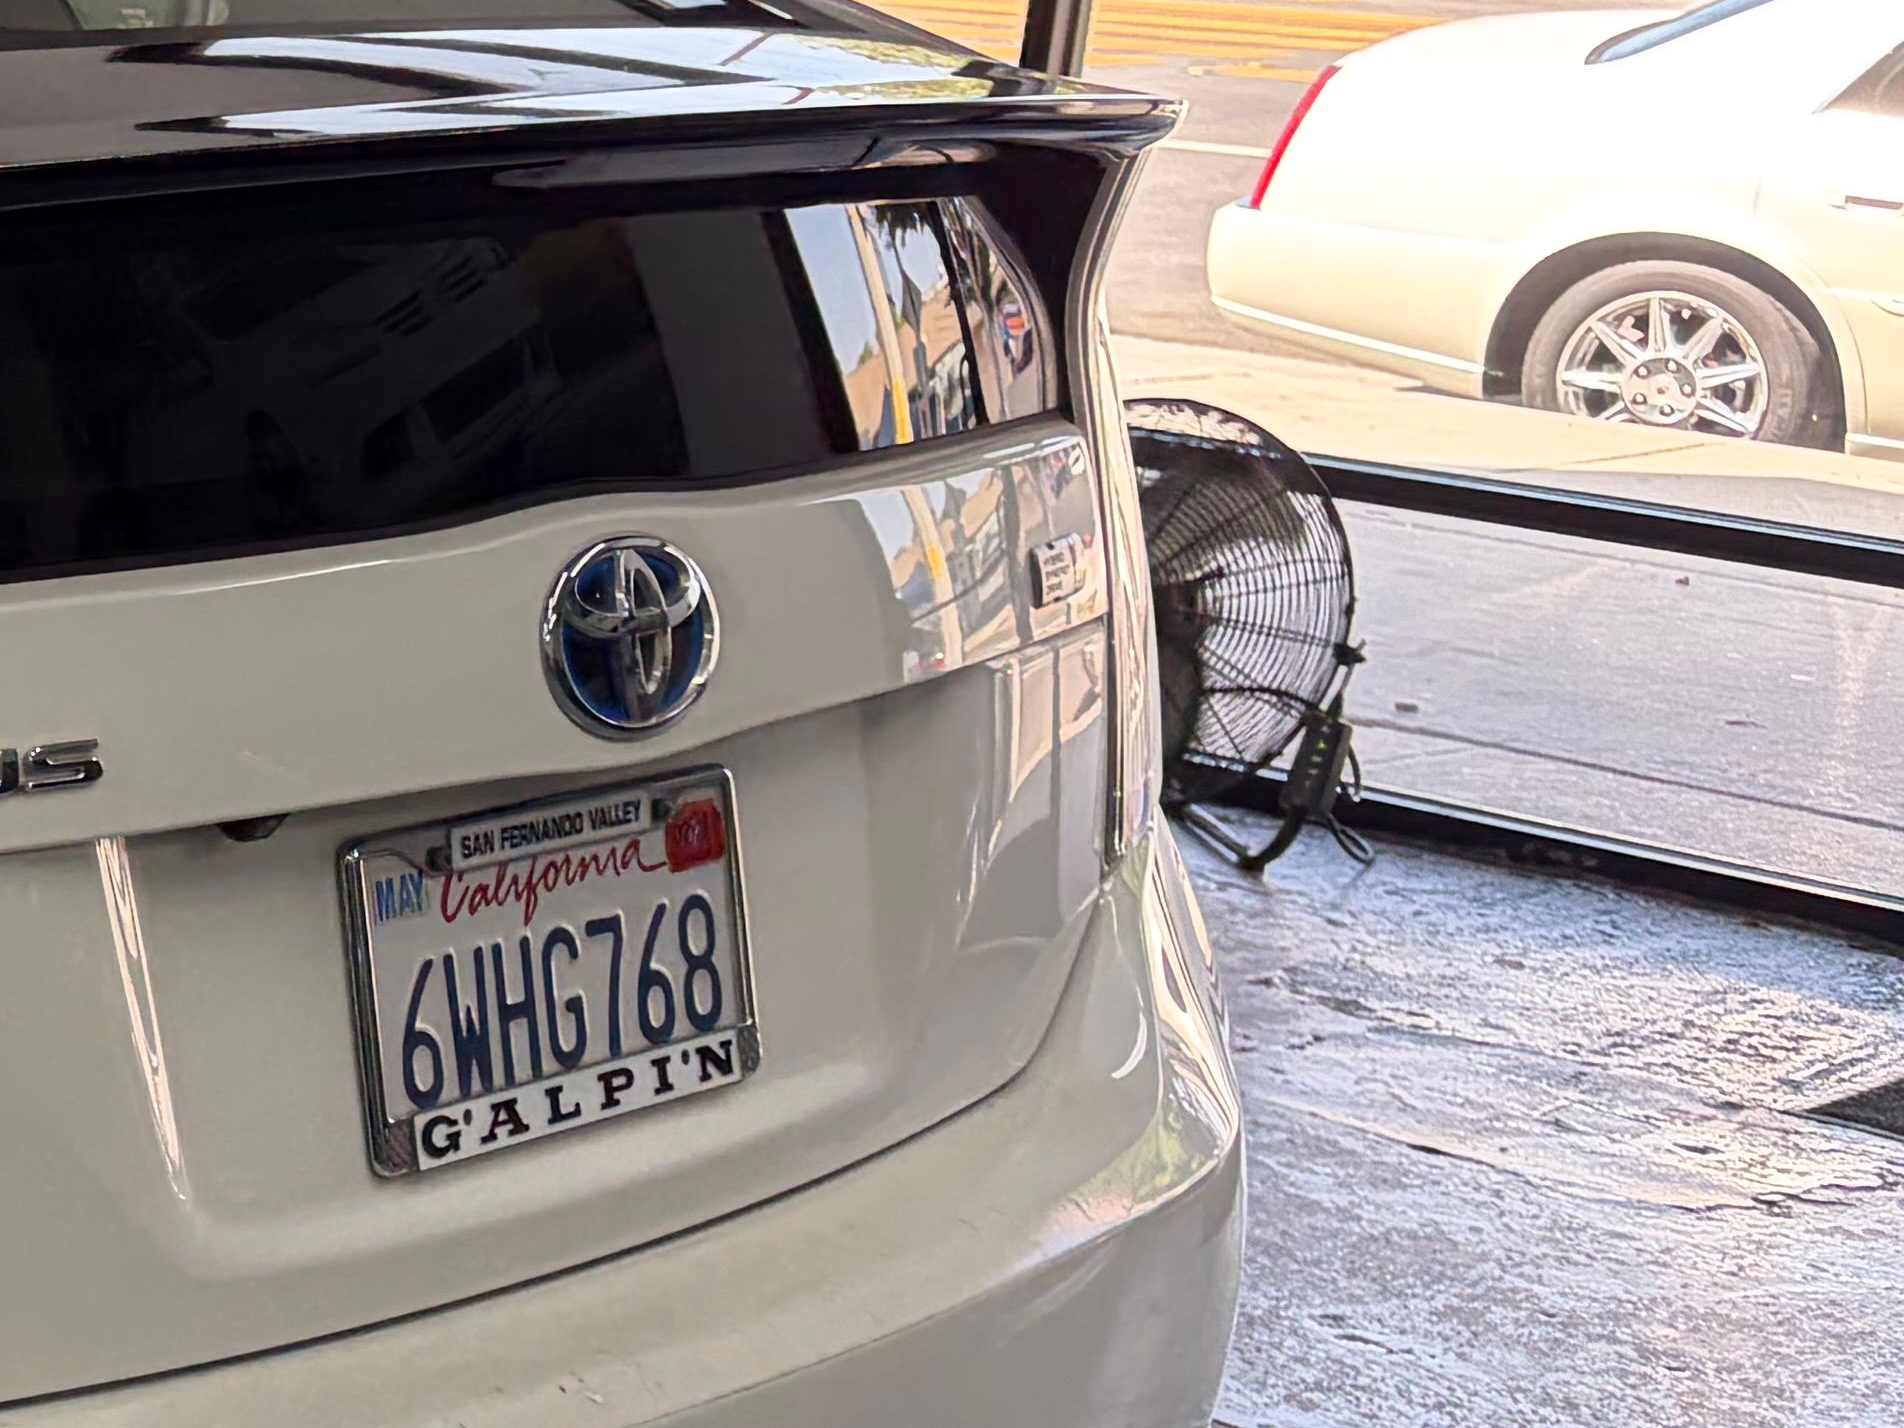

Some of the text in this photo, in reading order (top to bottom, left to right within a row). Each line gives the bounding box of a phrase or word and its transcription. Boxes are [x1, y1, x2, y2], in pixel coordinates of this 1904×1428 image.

[460, 798, 641, 859] SAN FERNANDO VALLEY
[375, 869, 424, 922] MAY
[441, 837, 667, 926] California
[402, 888, 723, 1111] 6WHG768
